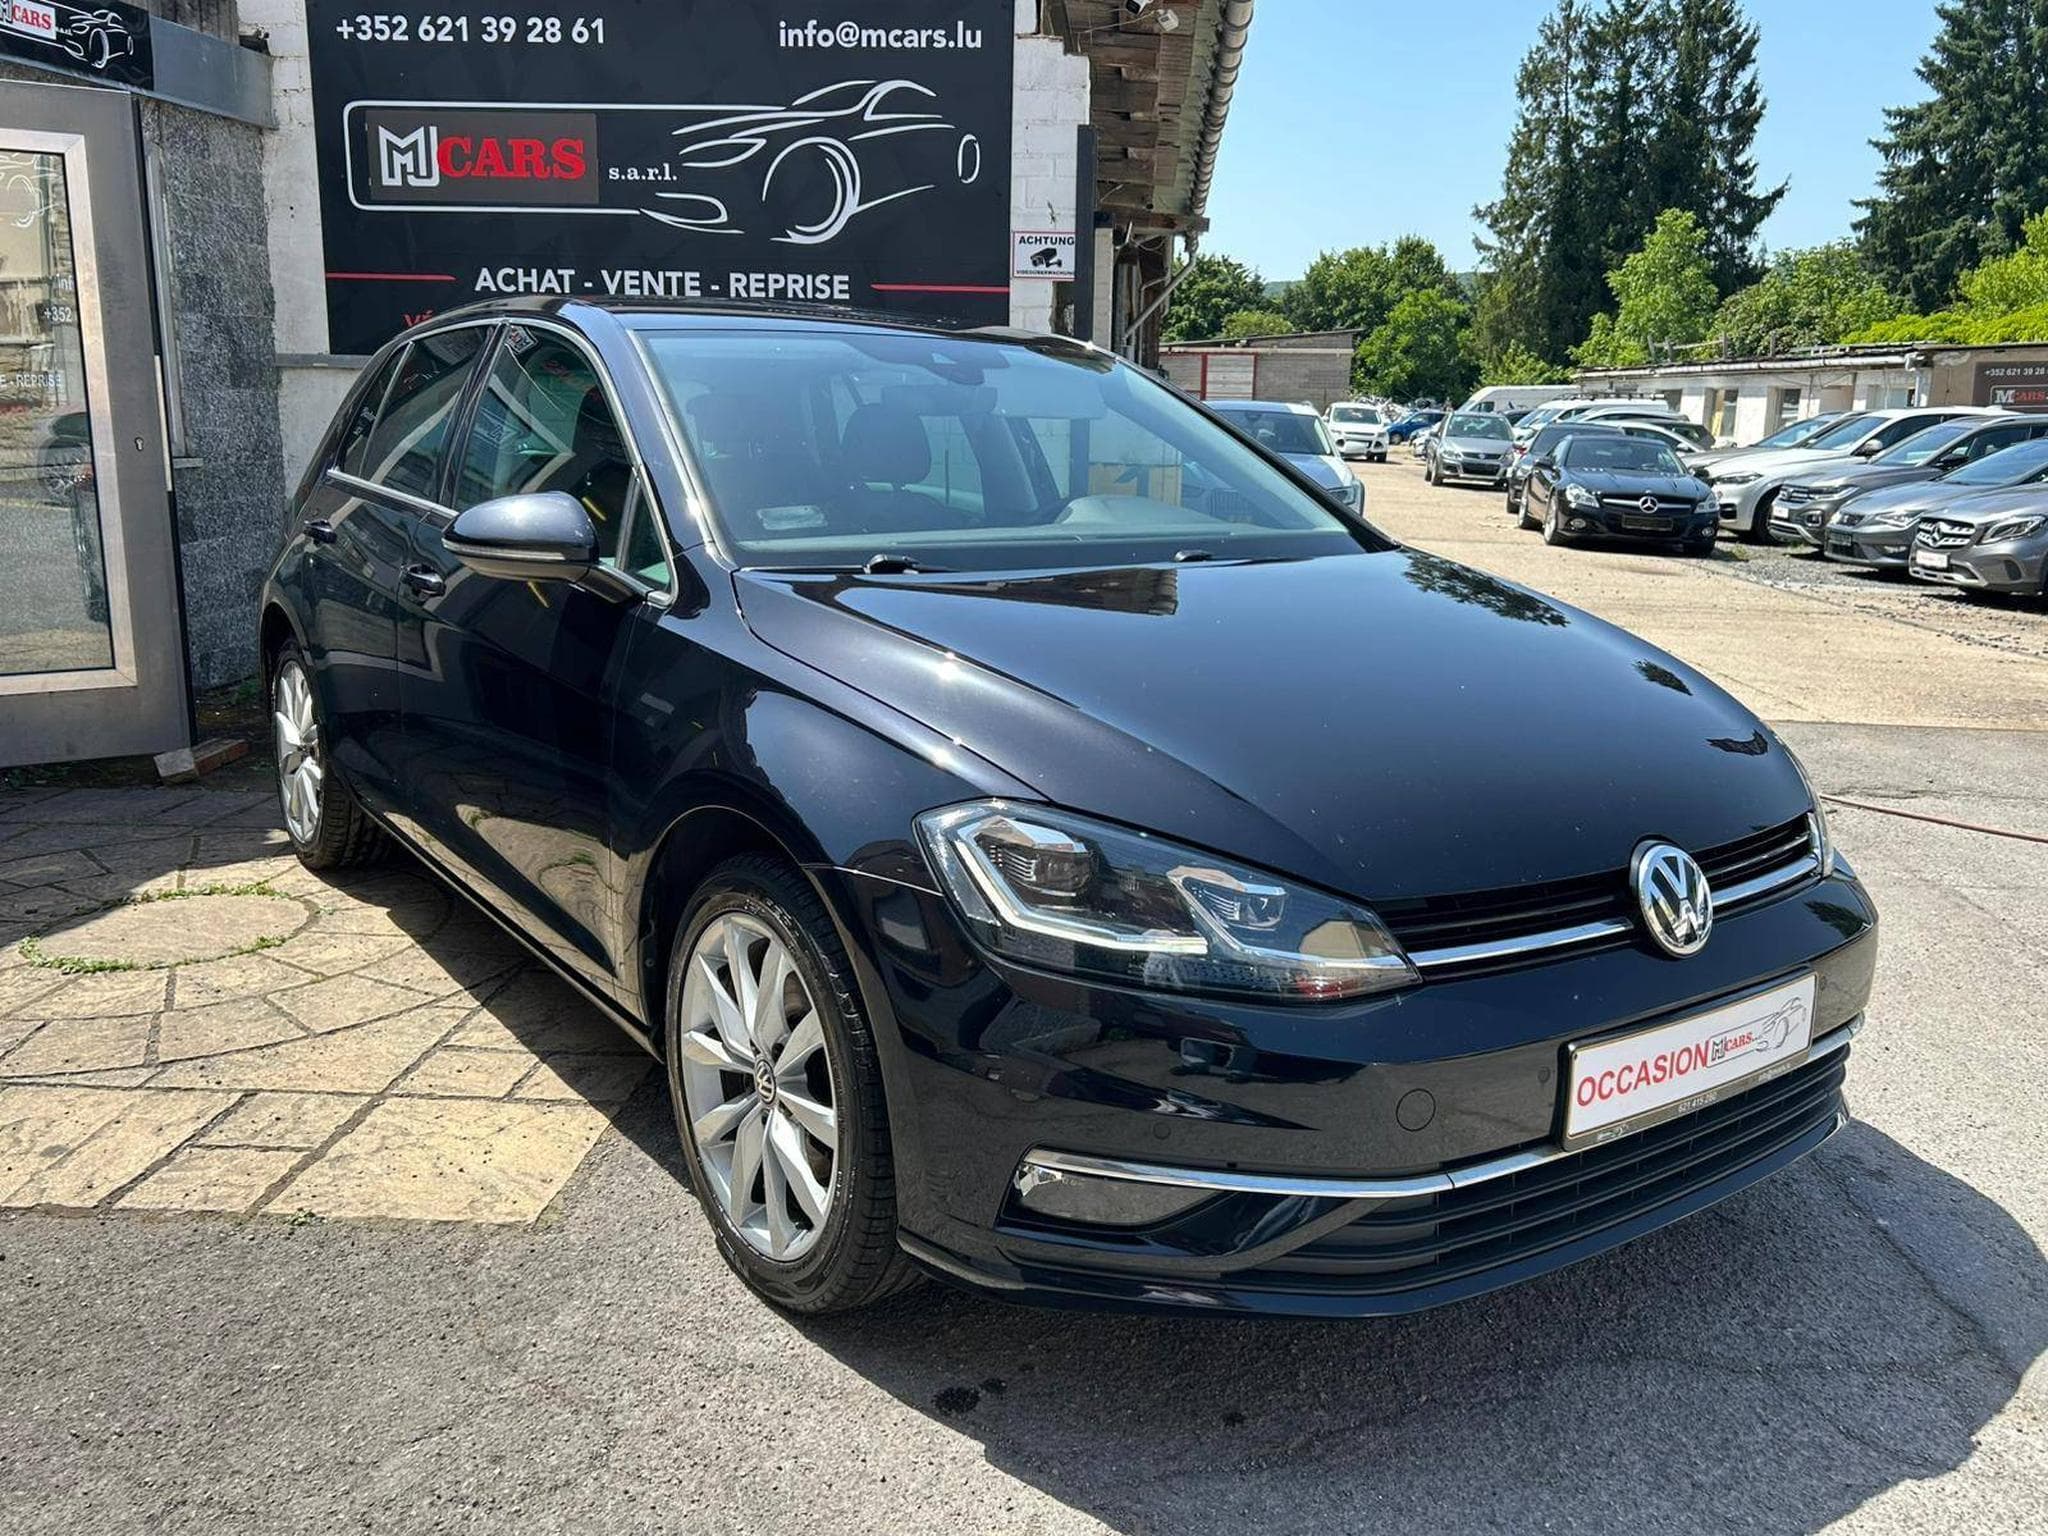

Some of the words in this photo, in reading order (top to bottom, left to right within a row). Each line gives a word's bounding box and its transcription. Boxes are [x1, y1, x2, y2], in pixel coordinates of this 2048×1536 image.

[13, 4, 52, 30] CARS
[336, 15, 409, 41] +352
[418, 16, 469, 42] 621
[481, 16, 517, 43] 39
[526, 18, 562, 44] 28
[571, 18, 605, 44] 61
[779, 19, 982, 49] info@mcars.lu
[608, 163, 678, 182] s.a.r.l.
[1019, 235, 1075, 246] ACHTUNG
[474, 268, 575, 294] ACHAT
[601, 270, 701, 297] VENTE
[729, 272, 851, 299] REPRISE
[43, 306, 73, 323] +352
[16, 374, 62, 388] REPRISE
[1577, 1039, 1709, 1107] OCCASION
